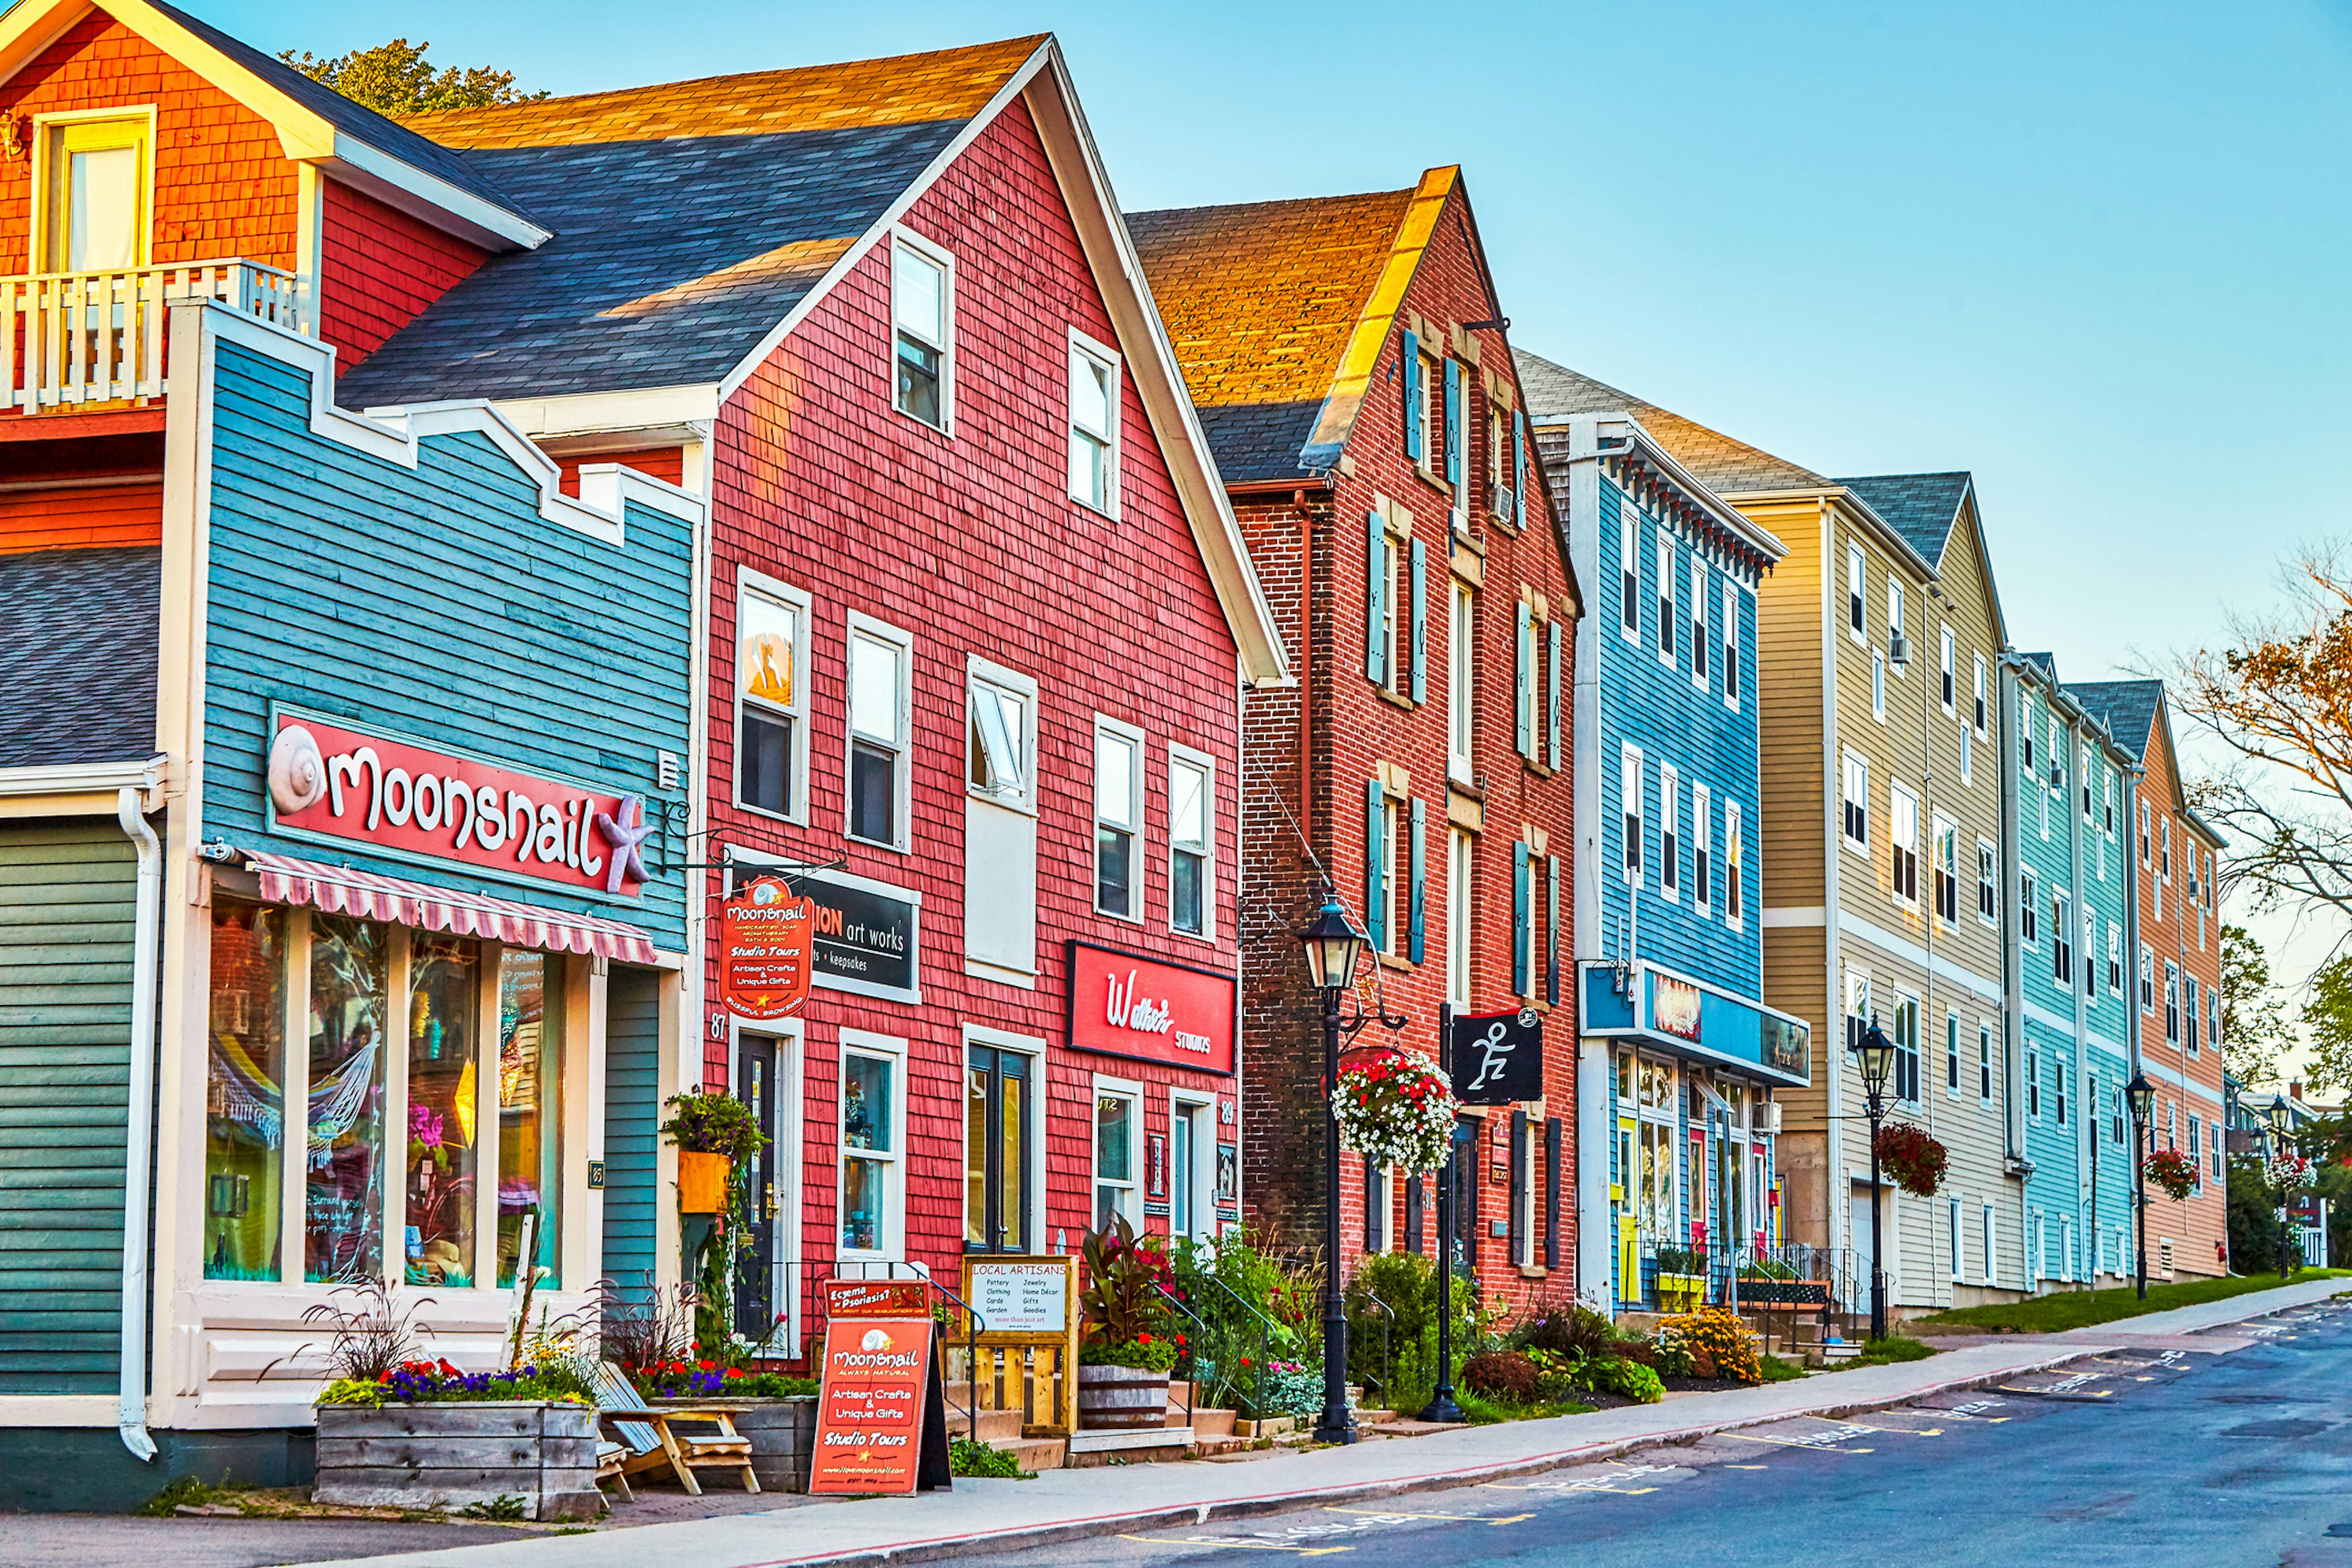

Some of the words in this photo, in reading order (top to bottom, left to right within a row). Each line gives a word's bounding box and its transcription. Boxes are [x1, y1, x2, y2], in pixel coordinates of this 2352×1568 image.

[328, 746, 603, 876] Moonsnail
[726, 903, 807, 922] Moonsnail
[815, 904, 843, 937] ION
[846, 923, 865, 943] art
[869, 926, 904, 952] works
[731, 945, 766, 956] Studio
[767, 946, 800, 956] Tours
[829, 950, 867, 971] keepsakes
[726, 996, 759, 1016] BLISSFUL
[763, 997, 803, 1016] BROWSING
[711, 1012, 726, 1040] 87
[1175, 1031, 1210, 1054] STUDIOS
[1221, 1101, 1234, 1125] 89
[973, 1265, 1006, 1275] LOCAL
[1010, 1265, 1066, 1275] ARTISANS
[831, 1287, 866, 1300] Eczema
[842, 1289, 889, 1309] Psoriasis?
[834, 1349, 919, 1368] Moonsnail
[832, 1389, 872, 1399] Artisan
[874, 1389, 911, 1399] Crafts
[866, 1399, 874, 1408] &
[835, 1409, 873, 1421] Unique
[876, 1409, 903, 1418] Gifts
[824, 1431, 867, 1446] Studio
[869, 1432, 908, 1446] Tours
